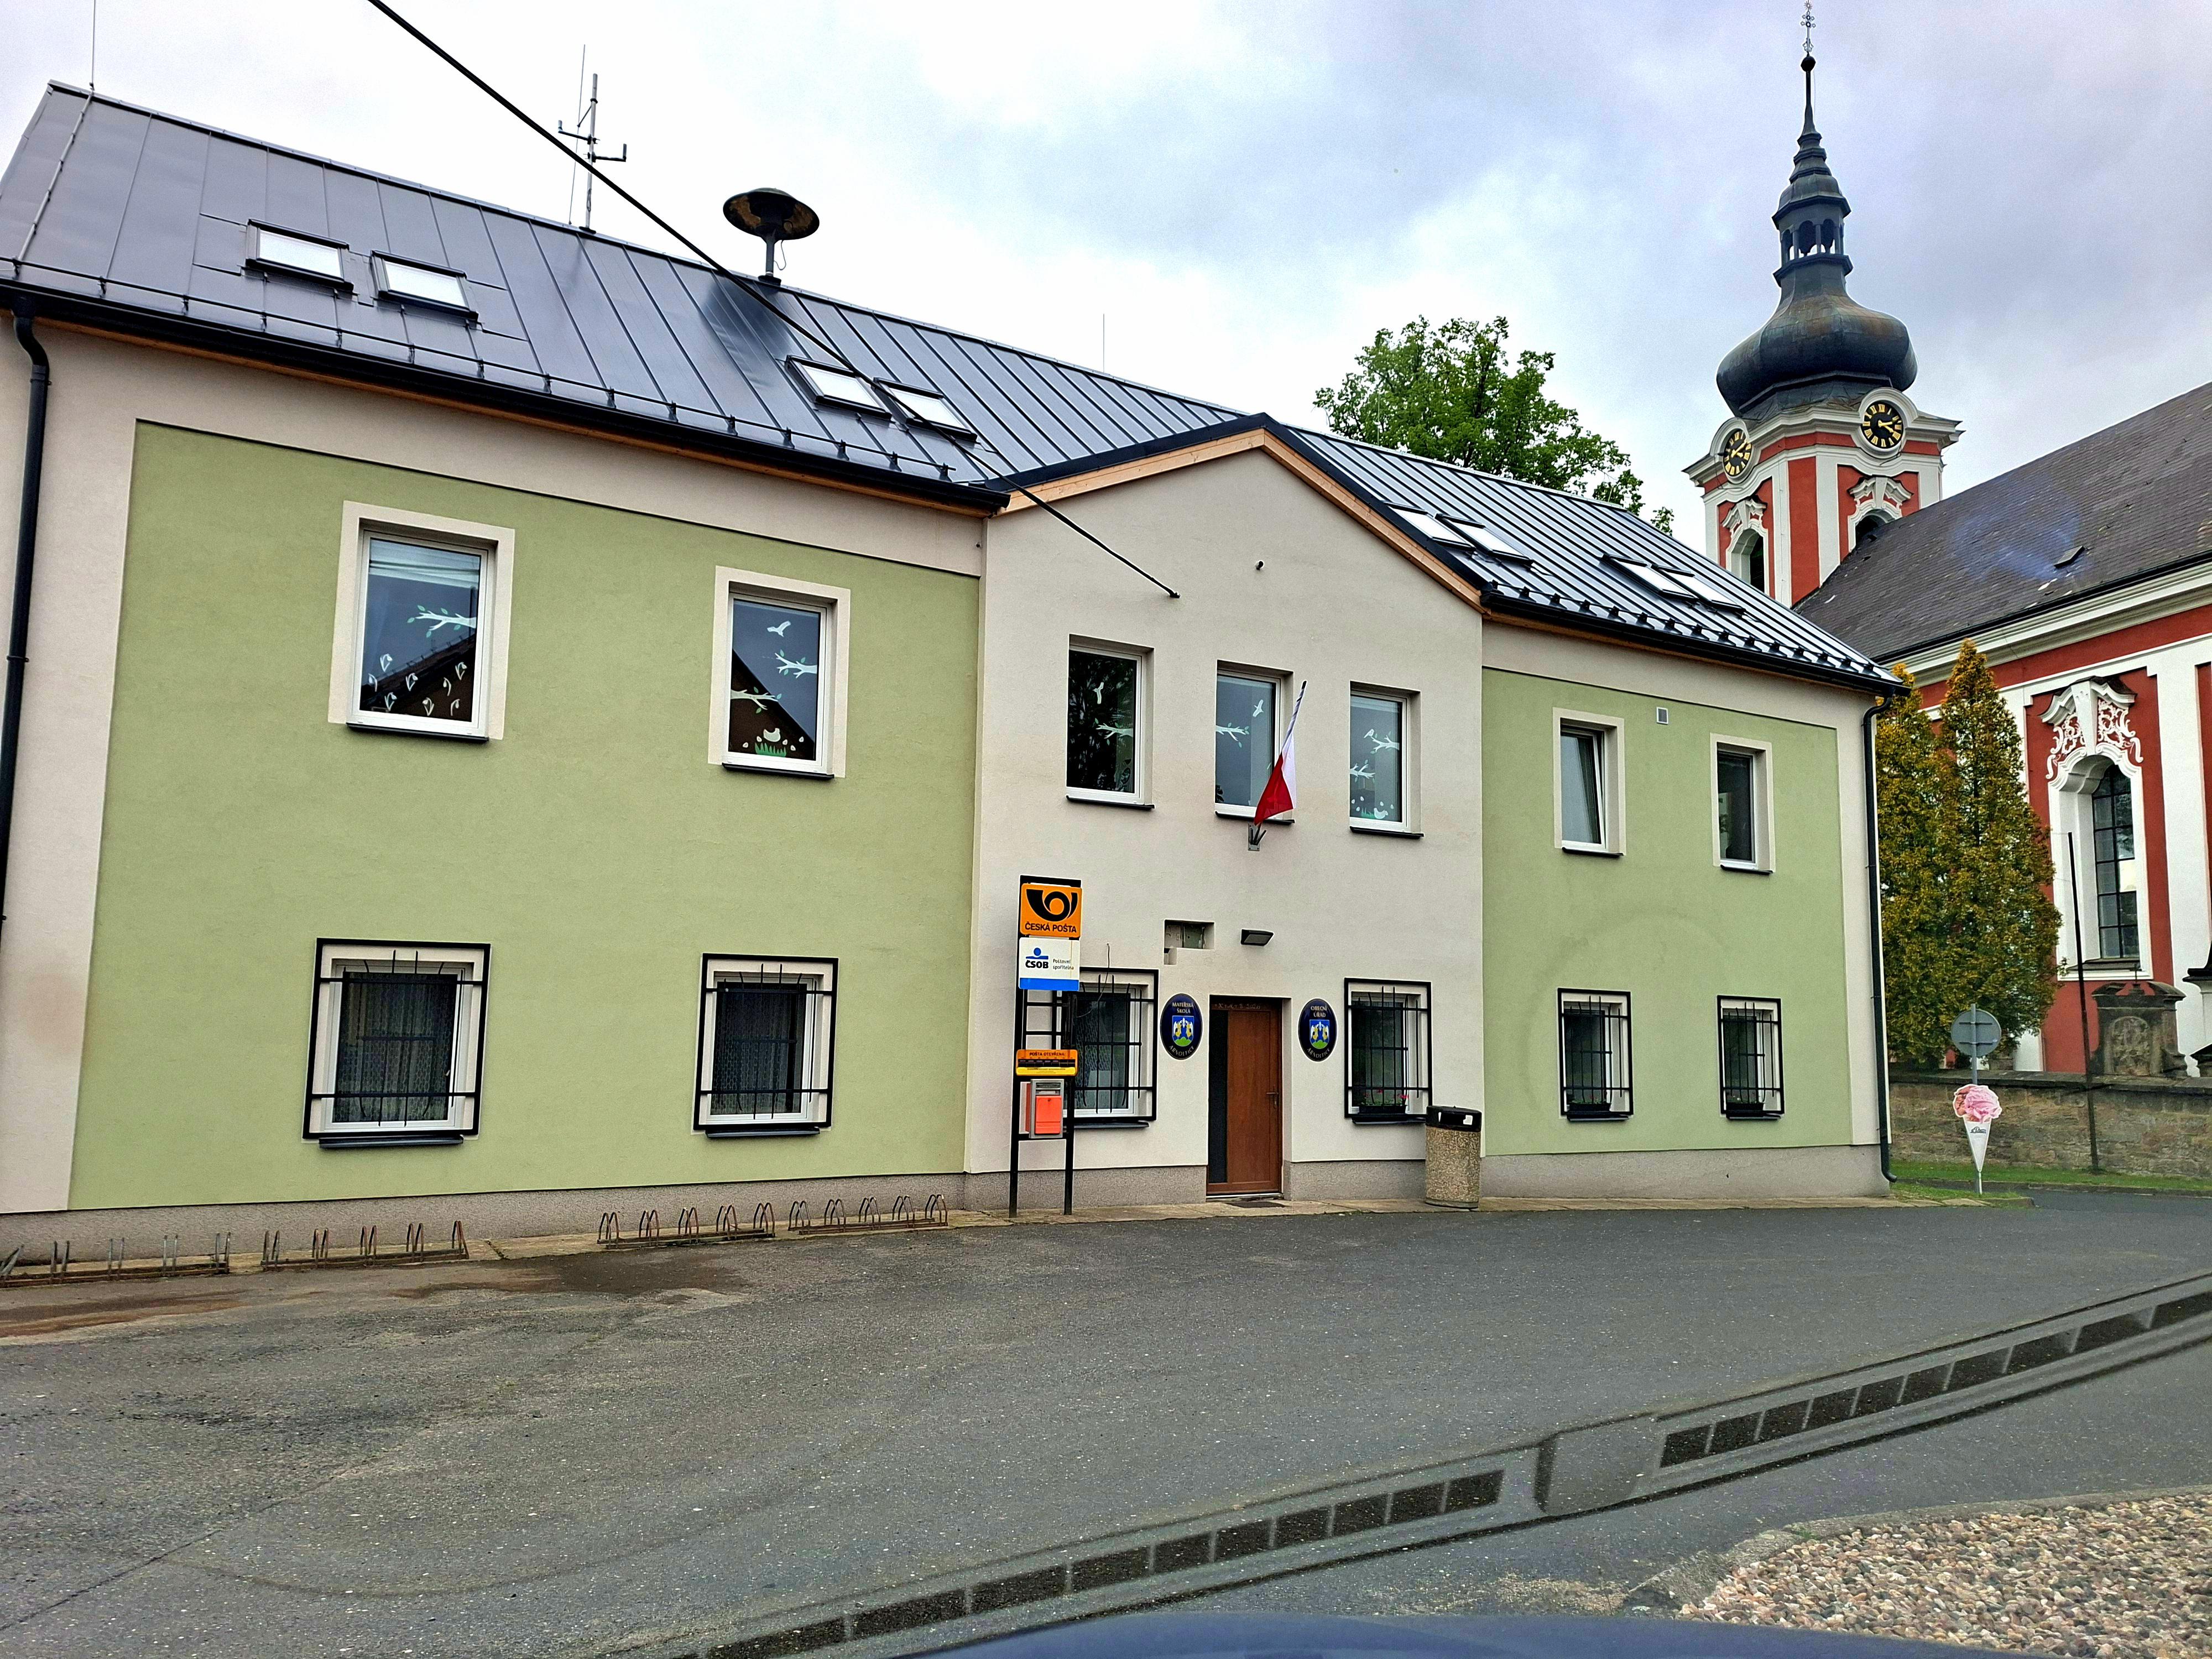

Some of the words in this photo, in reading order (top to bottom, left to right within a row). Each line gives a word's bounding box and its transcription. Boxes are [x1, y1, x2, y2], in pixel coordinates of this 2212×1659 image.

[1025, 921, 1050, 931] ČESKÁ
[1052, 924, 1077, 933] POŠTA
[1025, 959, 1049, 968] ČSOB
